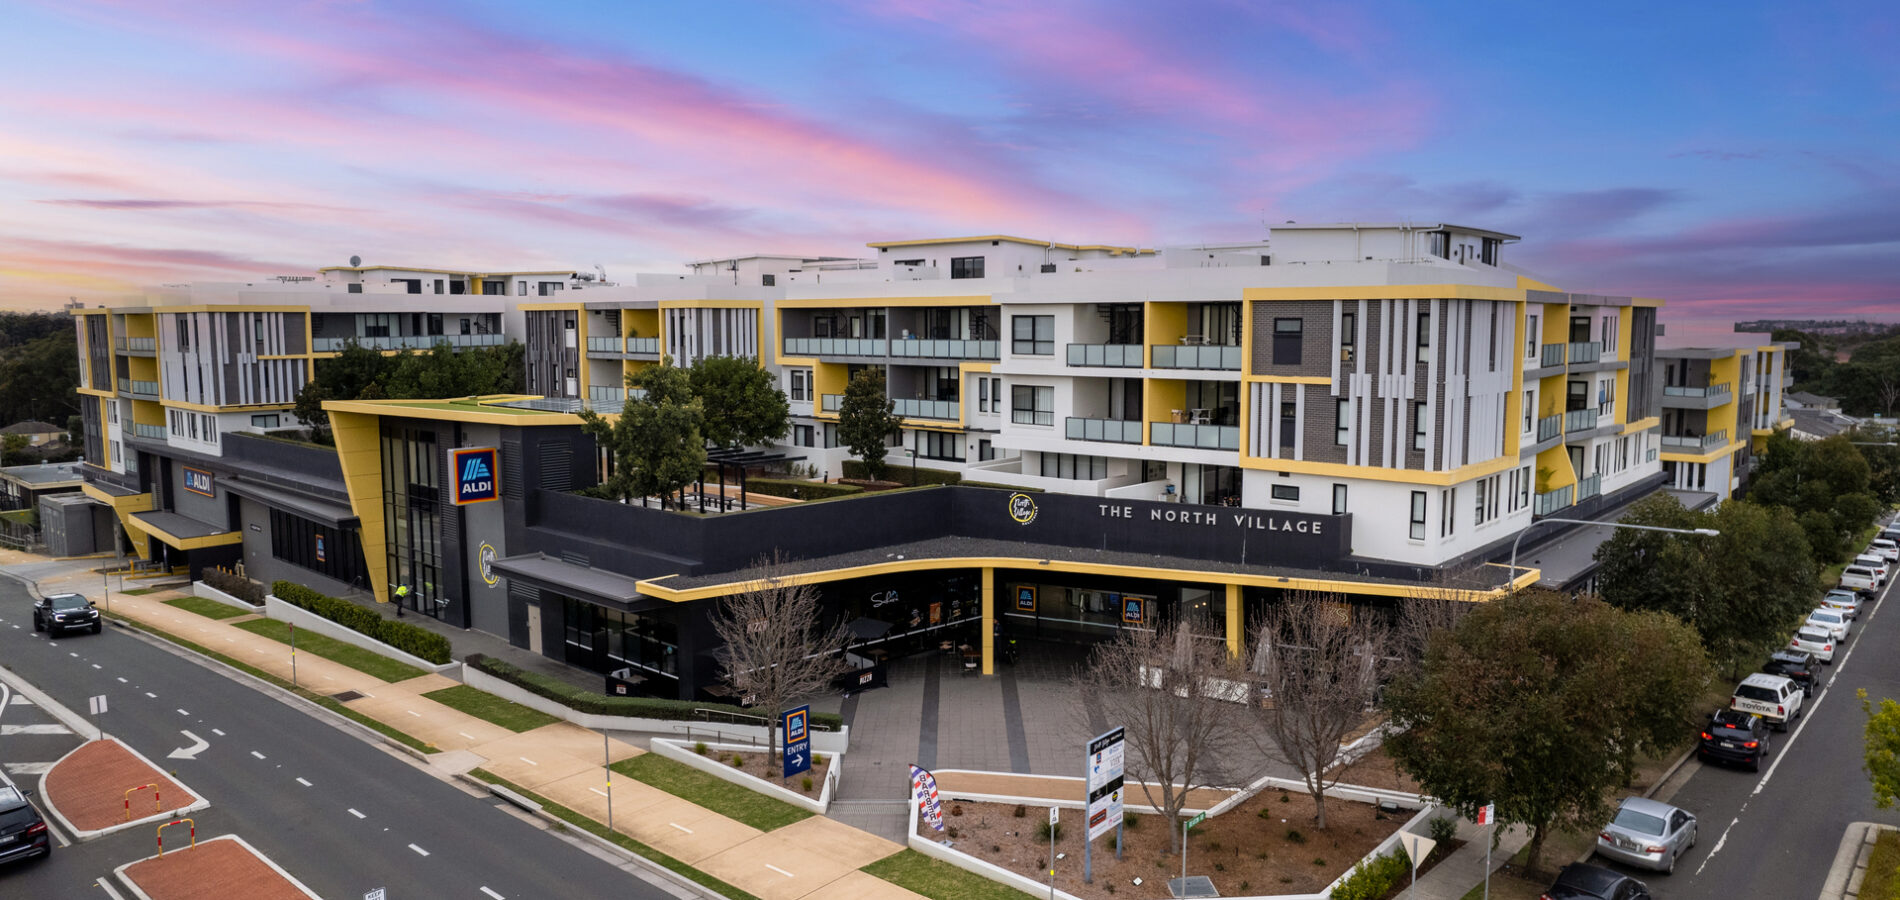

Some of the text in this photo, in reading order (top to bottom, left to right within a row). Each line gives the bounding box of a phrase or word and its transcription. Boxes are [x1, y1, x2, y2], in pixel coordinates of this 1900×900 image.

[193, 473, 210, 492] ALDI
[462, 481, 492, 494] ALDI
[1099, 505, 1322, 535] THE NORTH VILLAGE
[1125, 611, 1140, 619] ALDI
[1741, 702, 1771, 713] TOYOTA
[790, 727, 804, 737] ALDI
[787, 741, 808, 756] ENTRY
[367, 890, 382, 899] KEEP
